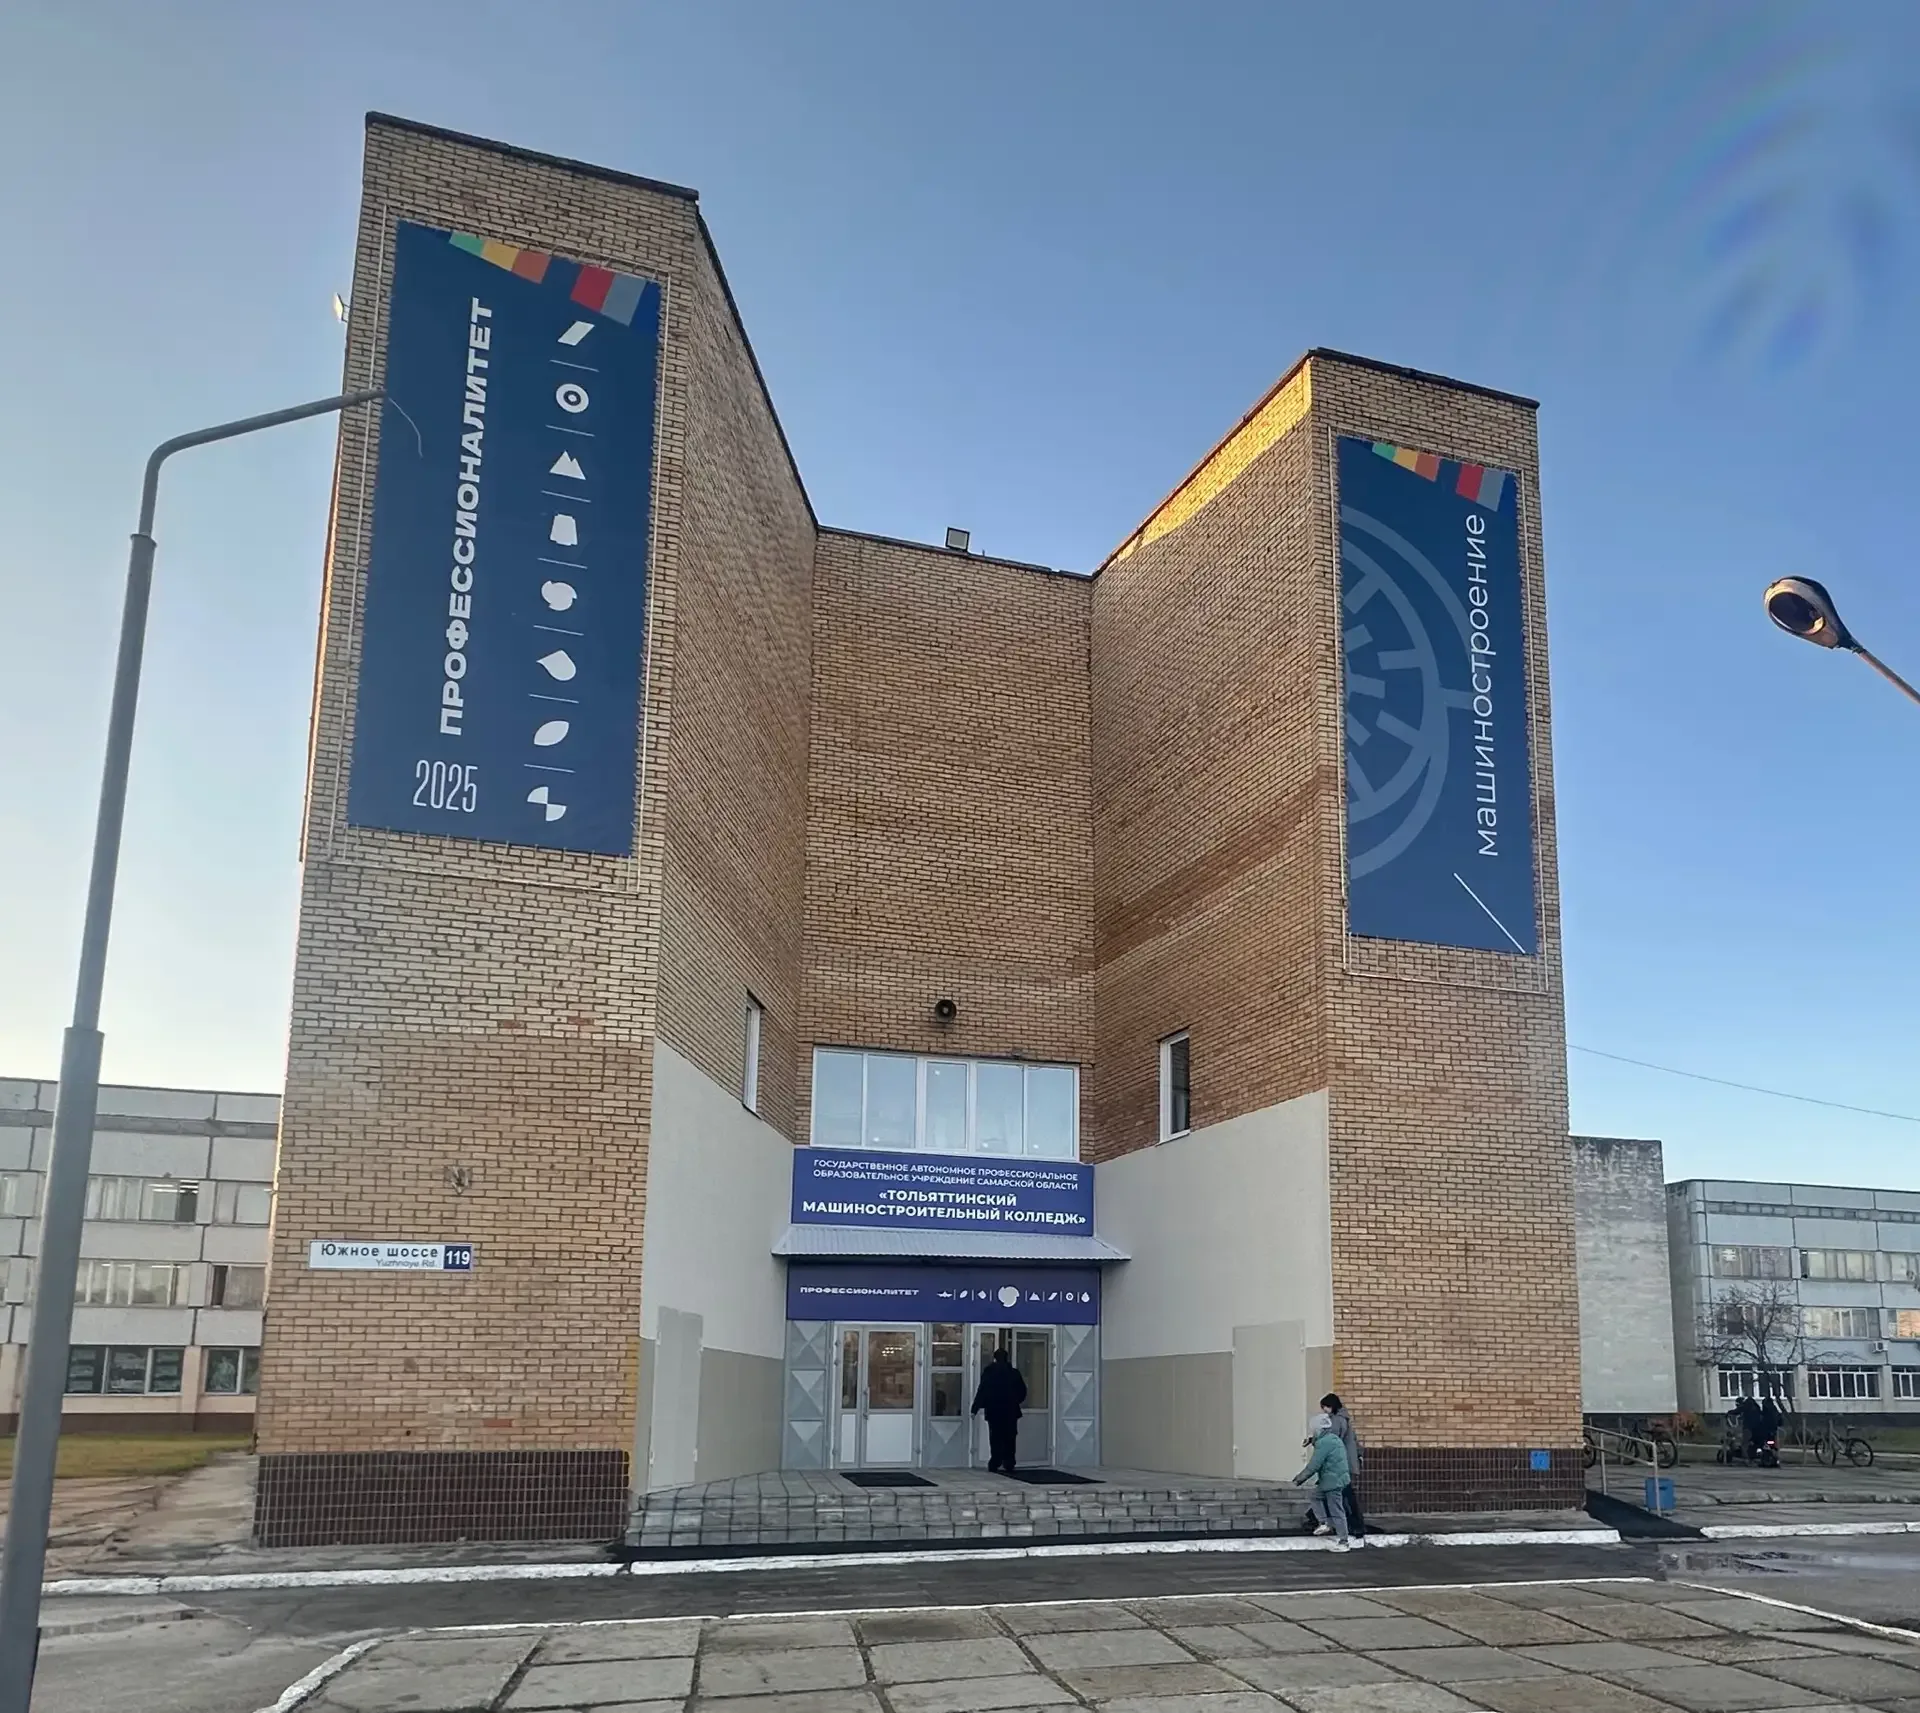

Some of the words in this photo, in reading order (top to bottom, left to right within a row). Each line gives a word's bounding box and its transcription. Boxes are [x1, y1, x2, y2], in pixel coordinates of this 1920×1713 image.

[439, 297, 494, 736] ПРОФЕССИОНАЛИТЕТ
[1464, 514, 1499, 857] машиностроение
[412, 759, 479, 815] 2025
[813, 1159, 908, 1172] ГОСУДАРСТВЕННОЕ
[910, 1164, 976, 1176] АВТОНОМНОЕ
[978, 1168, 1078, 1181] ПРОФЕССИОНАЛЬНОЕ
[813, 1169, 909, 1182] ОБРАЗОВАТЕЛЬНОЕ
[911, 1174, 975, 1185] УЧРЕЖДЕНИЕ
[977, 1177, 1034, 1189] САМАРСКОЙ
[1035, 1181, 1078, 1191] ОБЛАСТИ
[879, 1189, 1017, 1207] «ТОЛЬЯТТИНСКИЙ
[802, 1201, 1000, 1221] МАШИНОСТРОИТЕЛЬНЫЙ
[1004, 1210, 1087, 1225] КОЛЛЕДЖ»
[321, 1243, 380, 1257] Южное
[387, 1247, 438, 1258] шоссе
[446, 1250, 470, 1265] 119
[800, 1286, 919, 1296] ПРОФЕССИОНАЛИТЕТ
